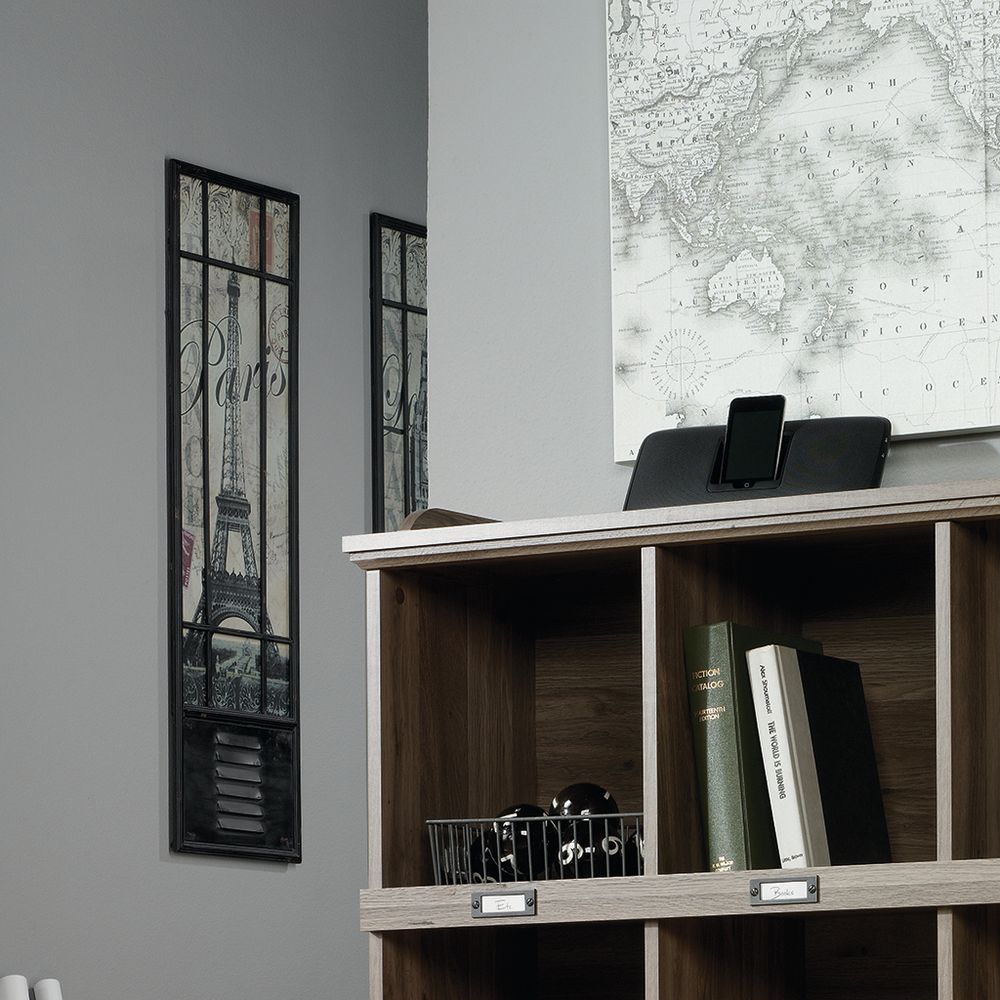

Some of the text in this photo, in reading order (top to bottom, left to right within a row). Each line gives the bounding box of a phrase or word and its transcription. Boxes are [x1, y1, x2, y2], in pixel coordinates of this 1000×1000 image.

[804, 78, 897, 100] NORTH
[778, 113, 927, 142] PACIFIC
[807, 158, 915, 182] OCEAN
[847, 269, 984, 296] SOUTH
[781, 314, 999, 346] PACIFIC OCEAN
[180, 316, 287, 416] Paris
[767, 721, 775, 734] THE
[769, 734, 779, 760] WORLD
[775, 768, 787, 800] BURNING
